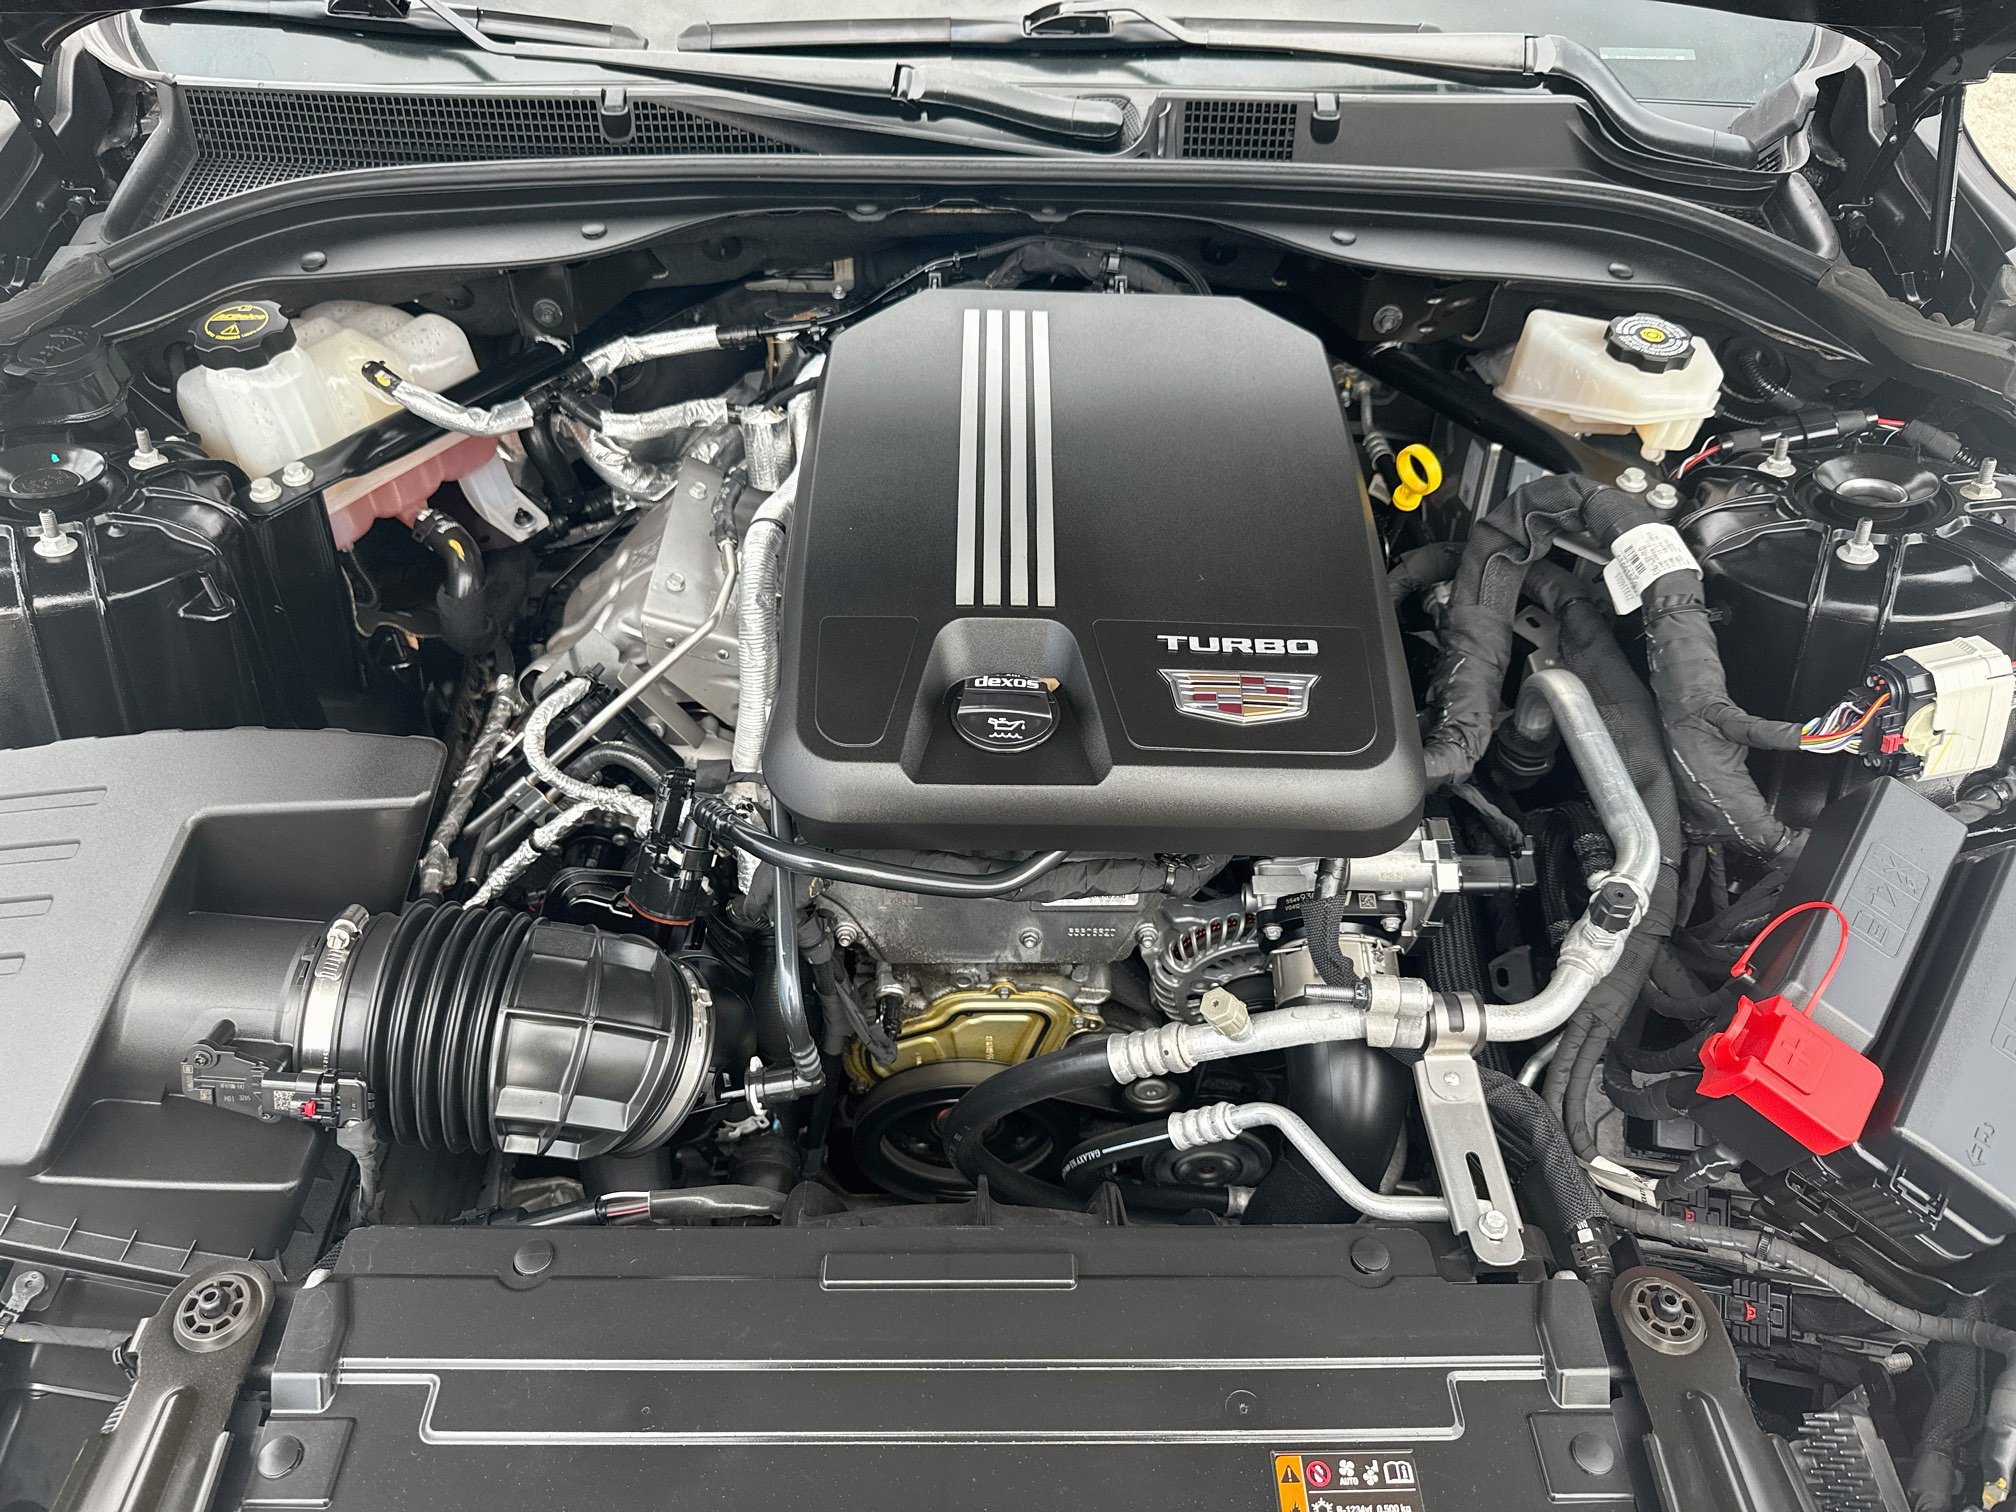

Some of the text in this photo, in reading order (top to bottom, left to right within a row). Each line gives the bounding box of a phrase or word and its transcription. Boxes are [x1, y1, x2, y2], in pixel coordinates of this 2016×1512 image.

[1157, 635, 1319, 655] TURBO
[974, 676, 1040, 689] dexos
[1075, 1148, 1101, 1166] GALAXY
[1339, 1476, 1359, 1486] AUTO
